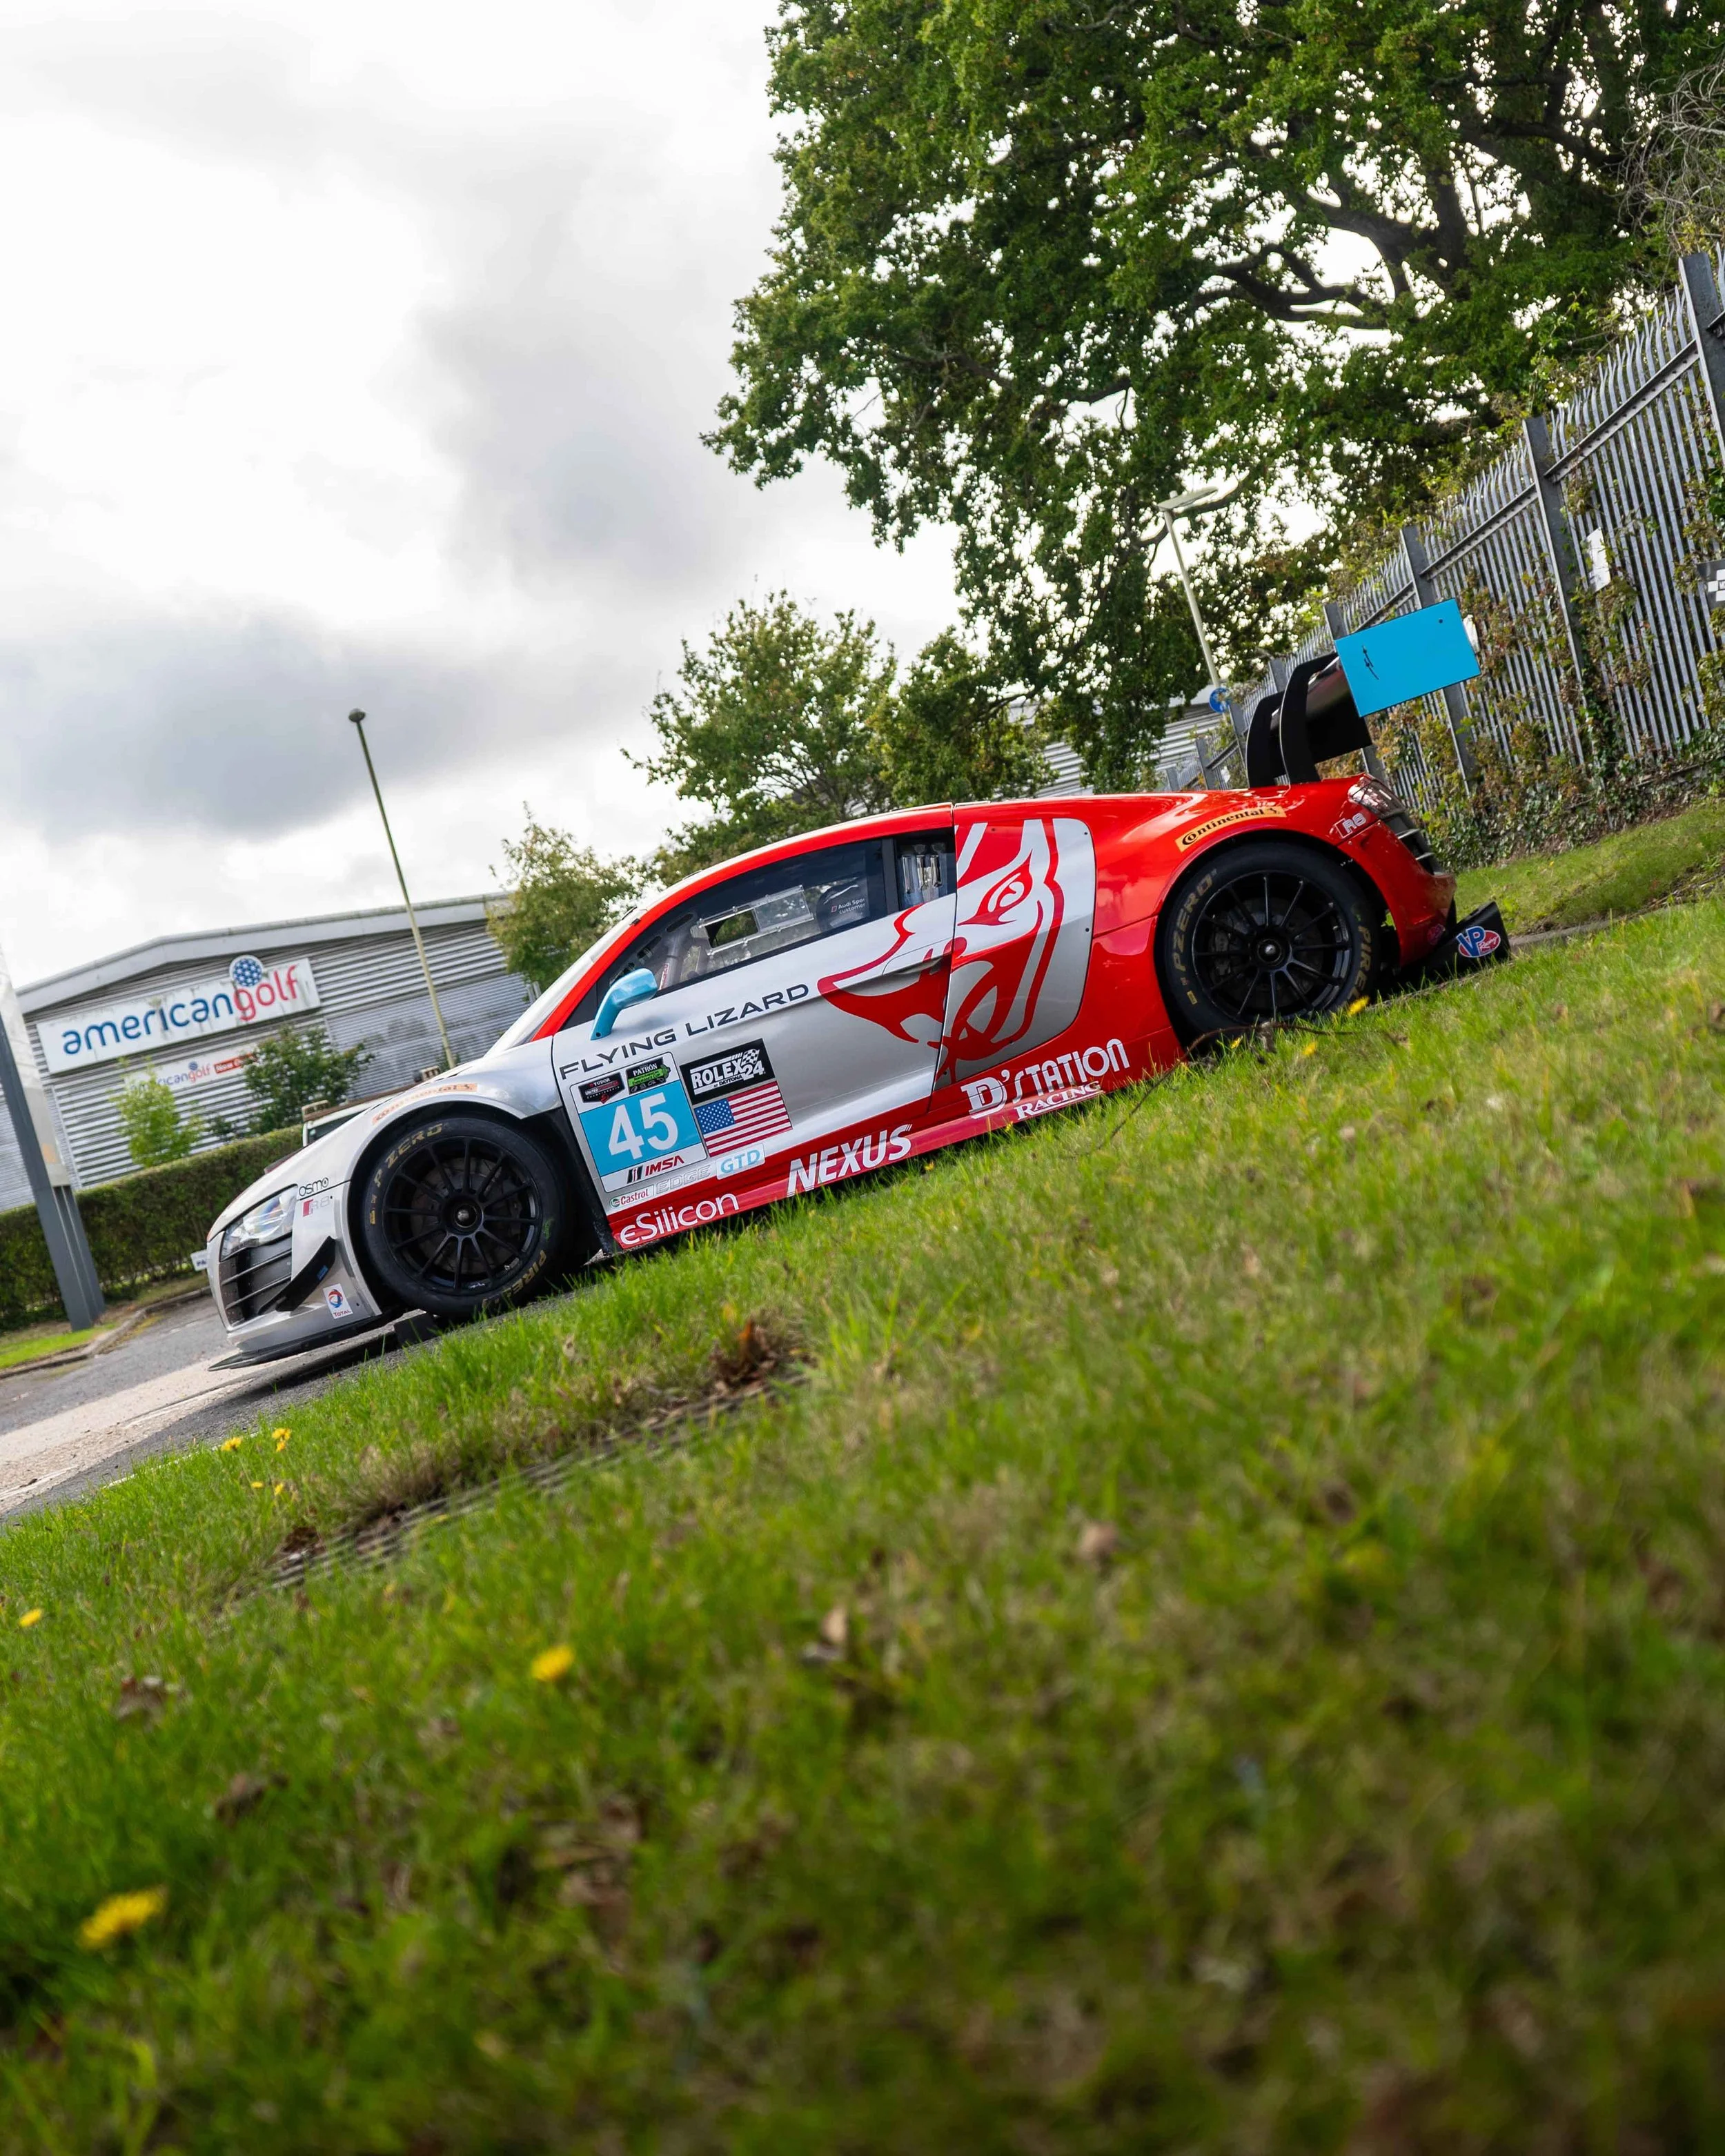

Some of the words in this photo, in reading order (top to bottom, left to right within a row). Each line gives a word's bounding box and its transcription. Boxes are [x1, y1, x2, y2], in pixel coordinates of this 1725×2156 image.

[1182, 809, 1265, 846] Continental
[1342, 813, 1366, 833] R8
[839, 903, 866, 914] customer
[1173, 873, 1213, 952] ZERO
[1456, 926, 1486, 958] VP
[560, 1028, 677, 1080] FLYING
[685, 984, 809, 1036] LIZARD
[593, 1078, 611, 1086] TUDOR
[633, 1063, 658, 1076] PATRÓN
[691, 1058, 743, 1089] ROLEX
[741, 1060, 765, 1080] 24
[719, 1075, 743, 1086] DAYTONA
[1014, 1081, 1101, 1120] RACING
[608, 1092, 678, 1160] 45
[385, 1123, 443, 1169] ZERO
[720, 1149, 761, 1174] GTD
[787, 1124, 912, 1198] NEXUS
[645, 1155, 684, 1176] IMSA
[299, 1177, 329, 1197] osmo
[620, 1188, 649, 1205] Castrol
[656, 1165, 712, 1194] EDGE
[620, 1193, 740, 1245] eSilicon
